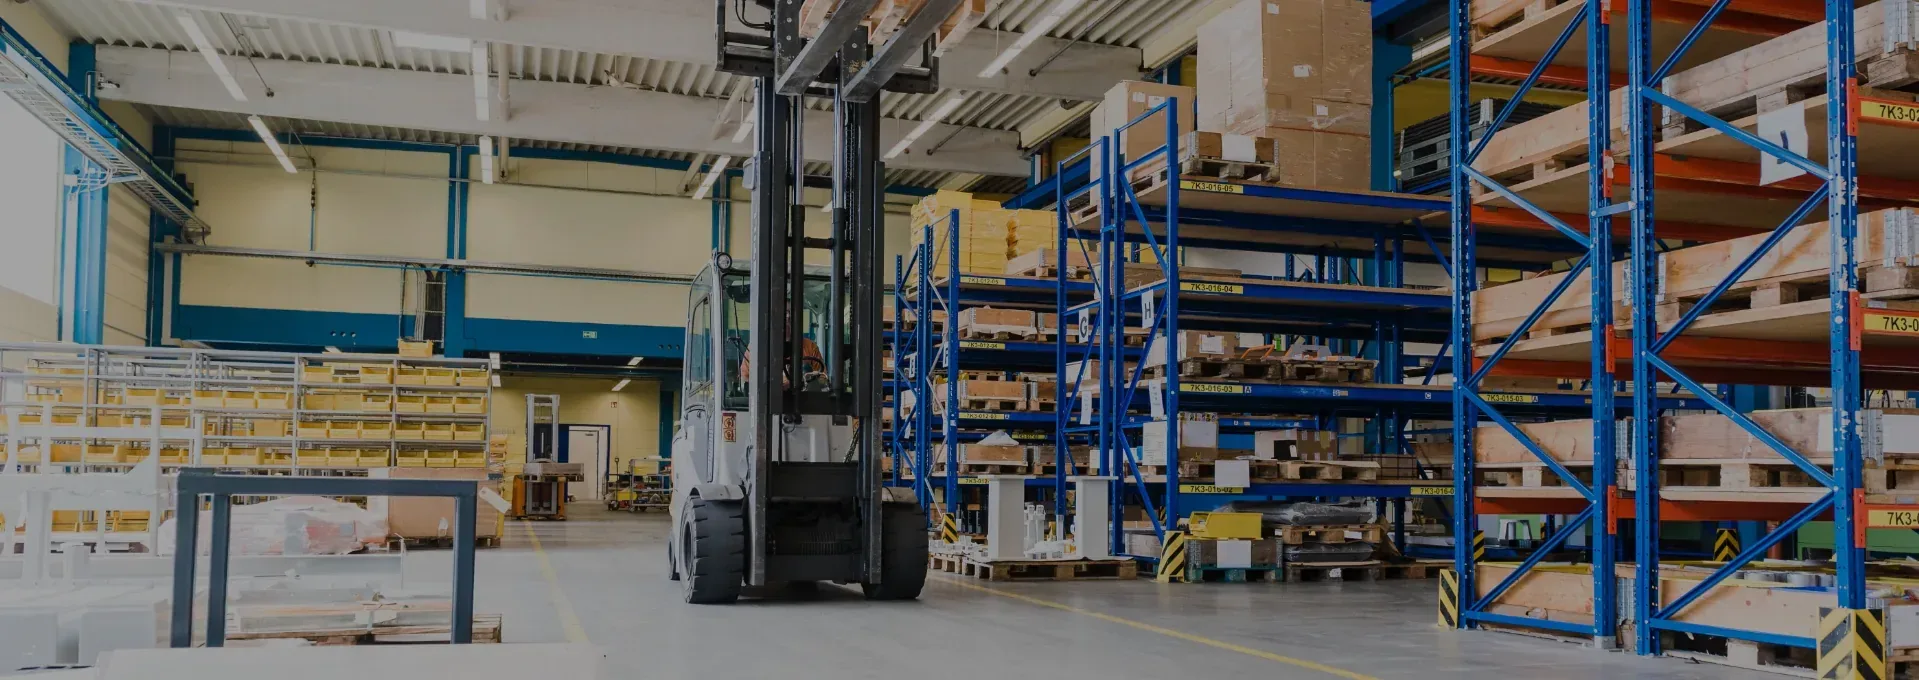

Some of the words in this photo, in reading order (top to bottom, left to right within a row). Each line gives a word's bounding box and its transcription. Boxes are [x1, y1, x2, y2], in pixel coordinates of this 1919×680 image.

[1191, 182, 1234, 192] 7K3-016-05
[1190, 283, 1233, 293] 7K3-016-04
[1144, 302, 1152, 320] H
[1080, 316, 1088, 338] G
[1190, 384, 1233, 393] 7K3-016-03
